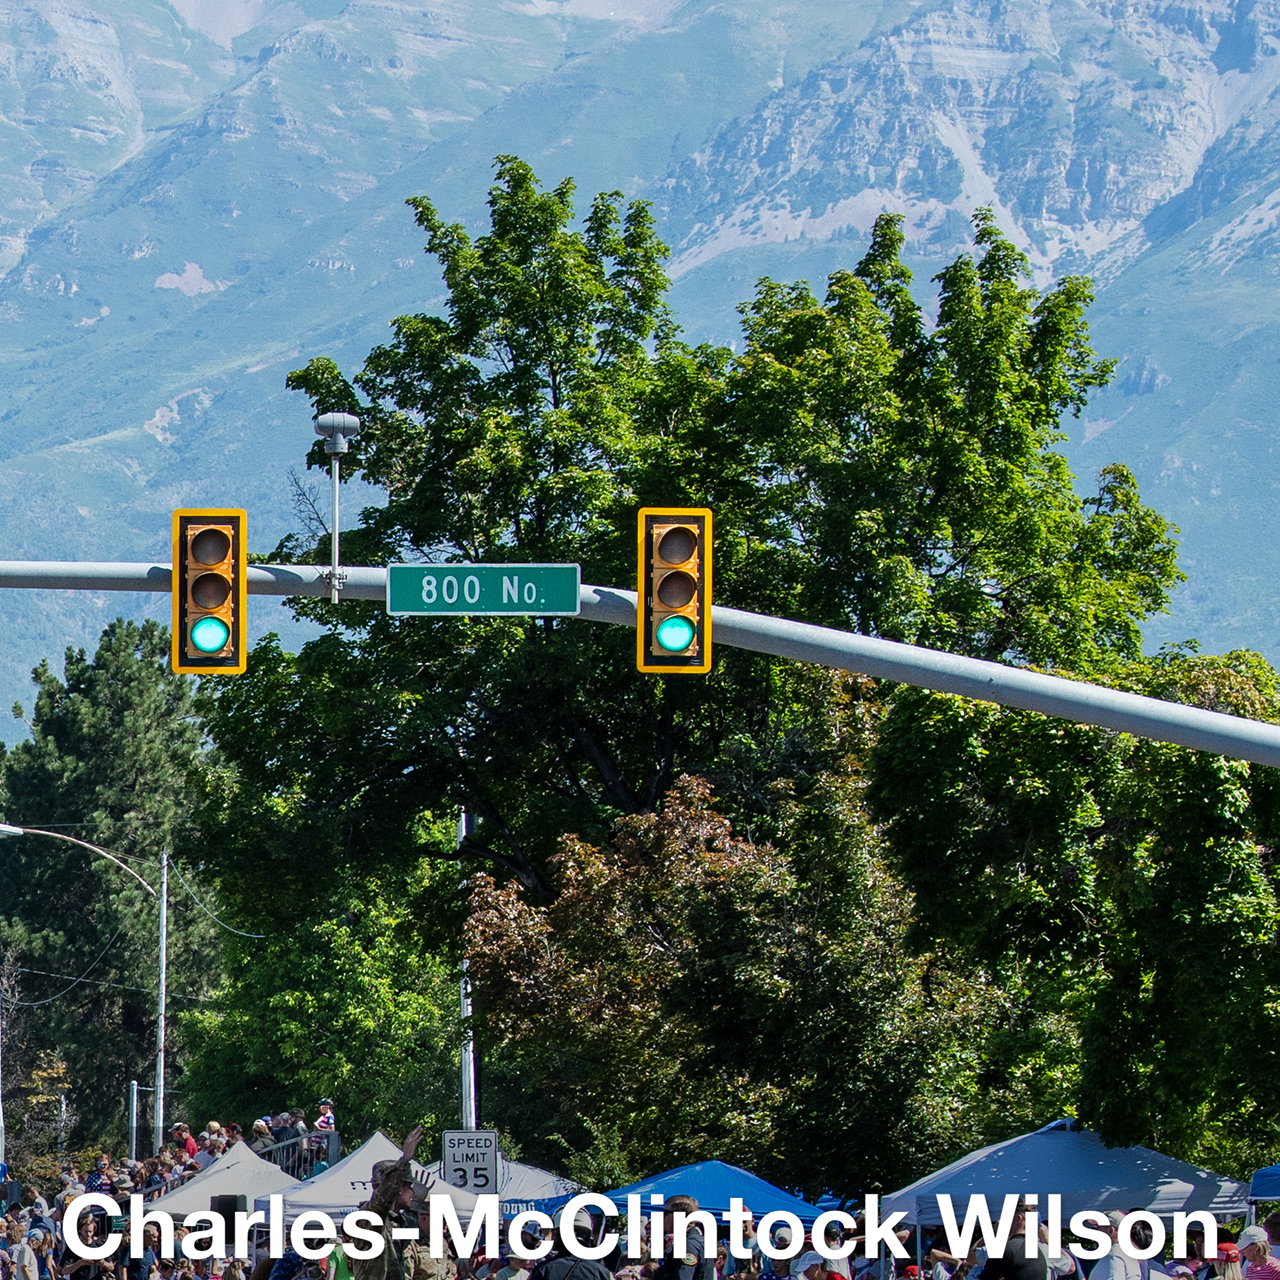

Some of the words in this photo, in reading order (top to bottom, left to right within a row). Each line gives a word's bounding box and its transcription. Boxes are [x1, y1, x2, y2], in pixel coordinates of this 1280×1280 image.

[421, 575, 480, 604] 800
[502, 575, 546, 604] No.
[448, 1138, 493, 1149] SPEED
[452, 1152, 488, 1163] LIMIT
[452, 1167, 490, 1188] 35
